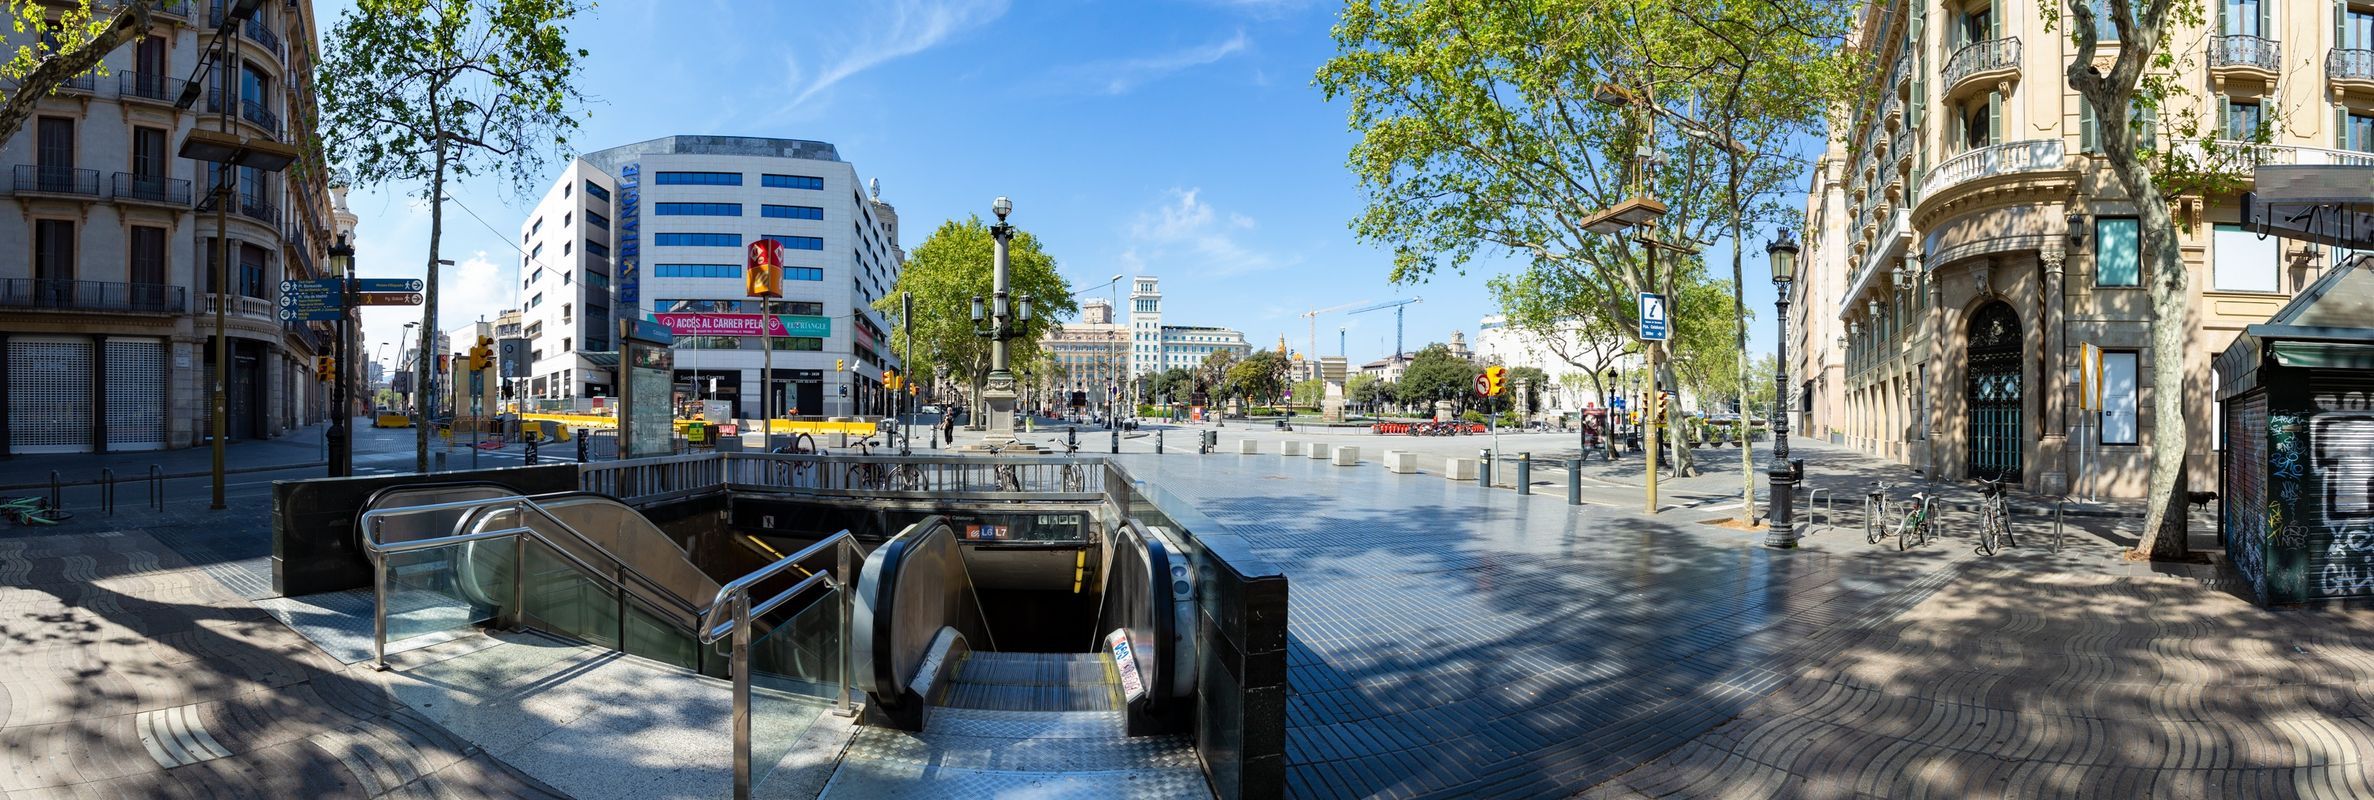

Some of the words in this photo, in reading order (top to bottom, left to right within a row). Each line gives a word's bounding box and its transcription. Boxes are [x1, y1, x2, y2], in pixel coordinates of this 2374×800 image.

[702, 318, 712, 328] AL
[713, 318, 743, 329] CARRER
[744, 319, 764, 329] PELA
[981, 528, 993, 537] L6
[995, 528, 1007, 537] L7
